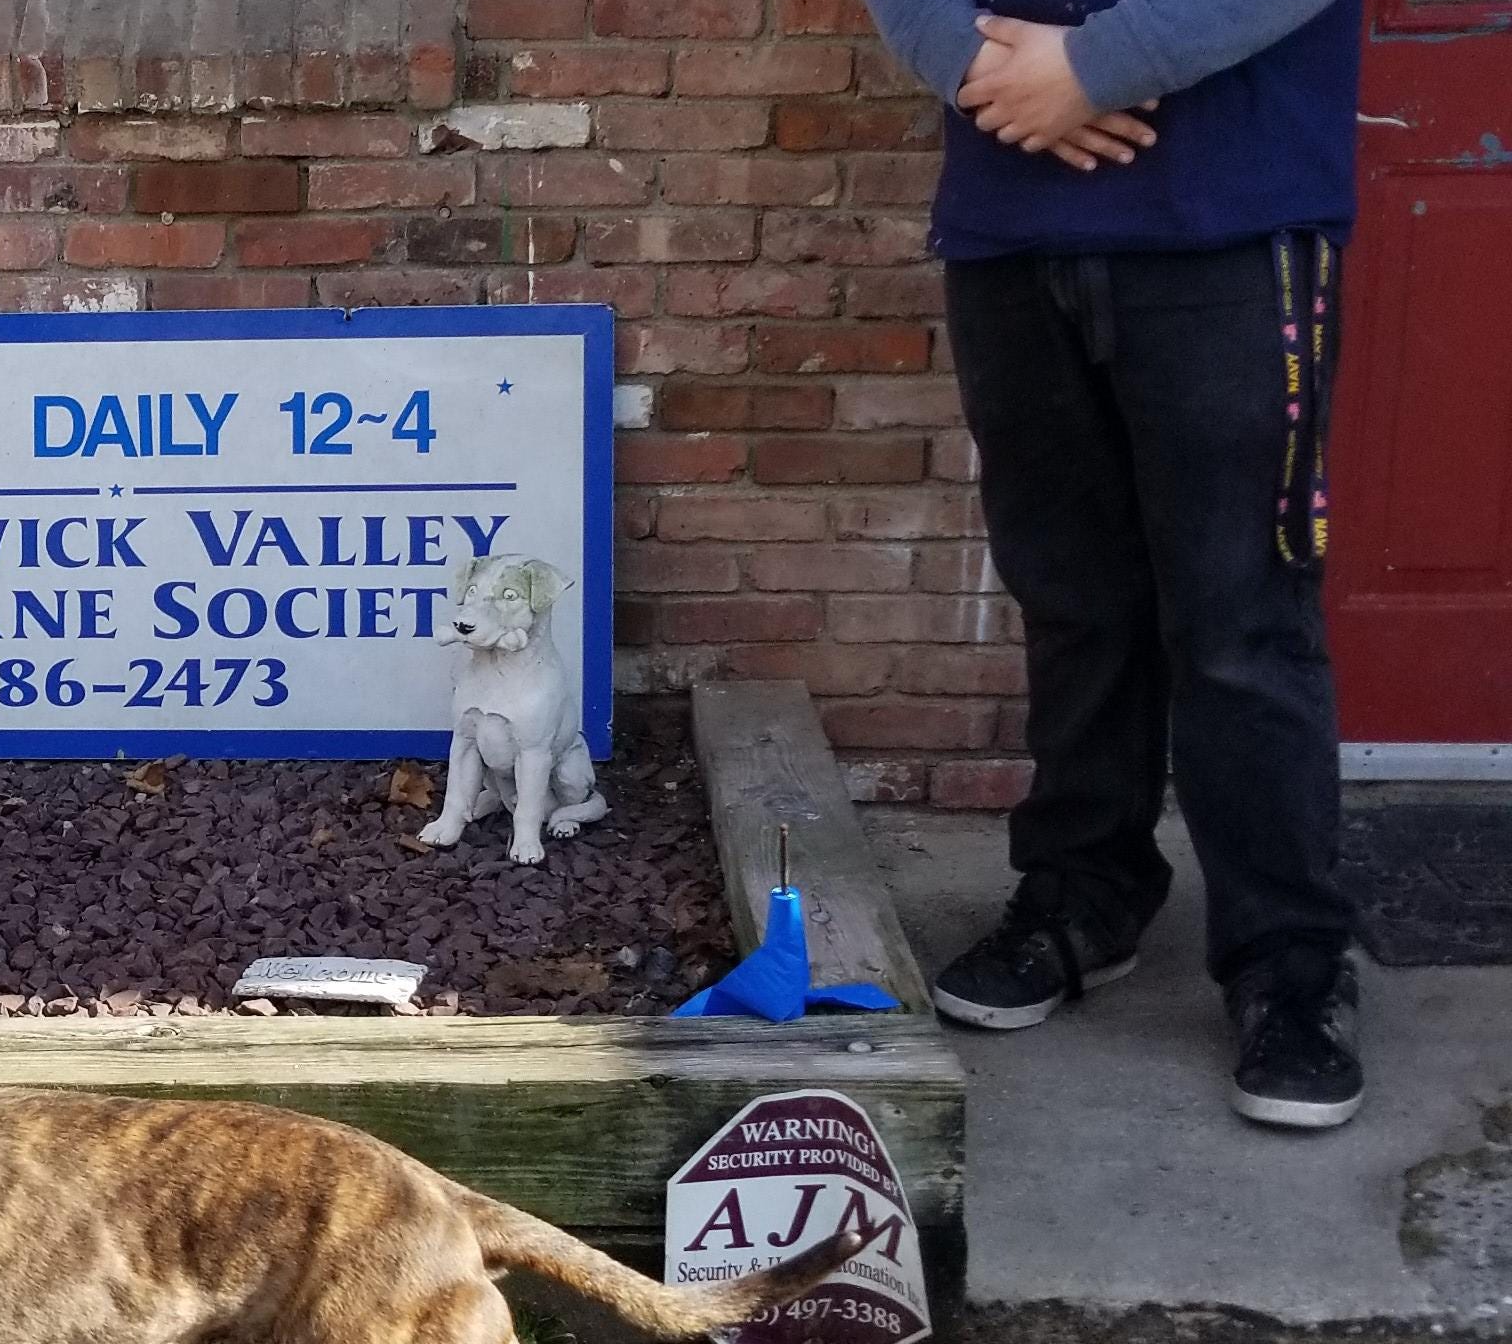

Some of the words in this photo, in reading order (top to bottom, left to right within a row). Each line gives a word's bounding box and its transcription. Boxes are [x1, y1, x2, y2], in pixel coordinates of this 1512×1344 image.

[33, 392, 240, 459] DAILY
[279, 389, 438, 456] 12~4
[185, 509, 511, 569] VALLEY
[152, 580, 449, 641] SOCIET
[739, 1117, 877, 1160] WARNING!
[707, 1149, 797, 1171] SECURITY
[799, 1148, 880, 1183] PROVIDED
[883, 1174, 901, 1198] BY
[683, 1183, 907, 1268] AJM
[677, 1259, 744, 1283] Security
[748, 1257, 762, 1273] &
[837, 1259, 906, 1296] tomation
[786, 1297, 902, 1335] 497-3388
